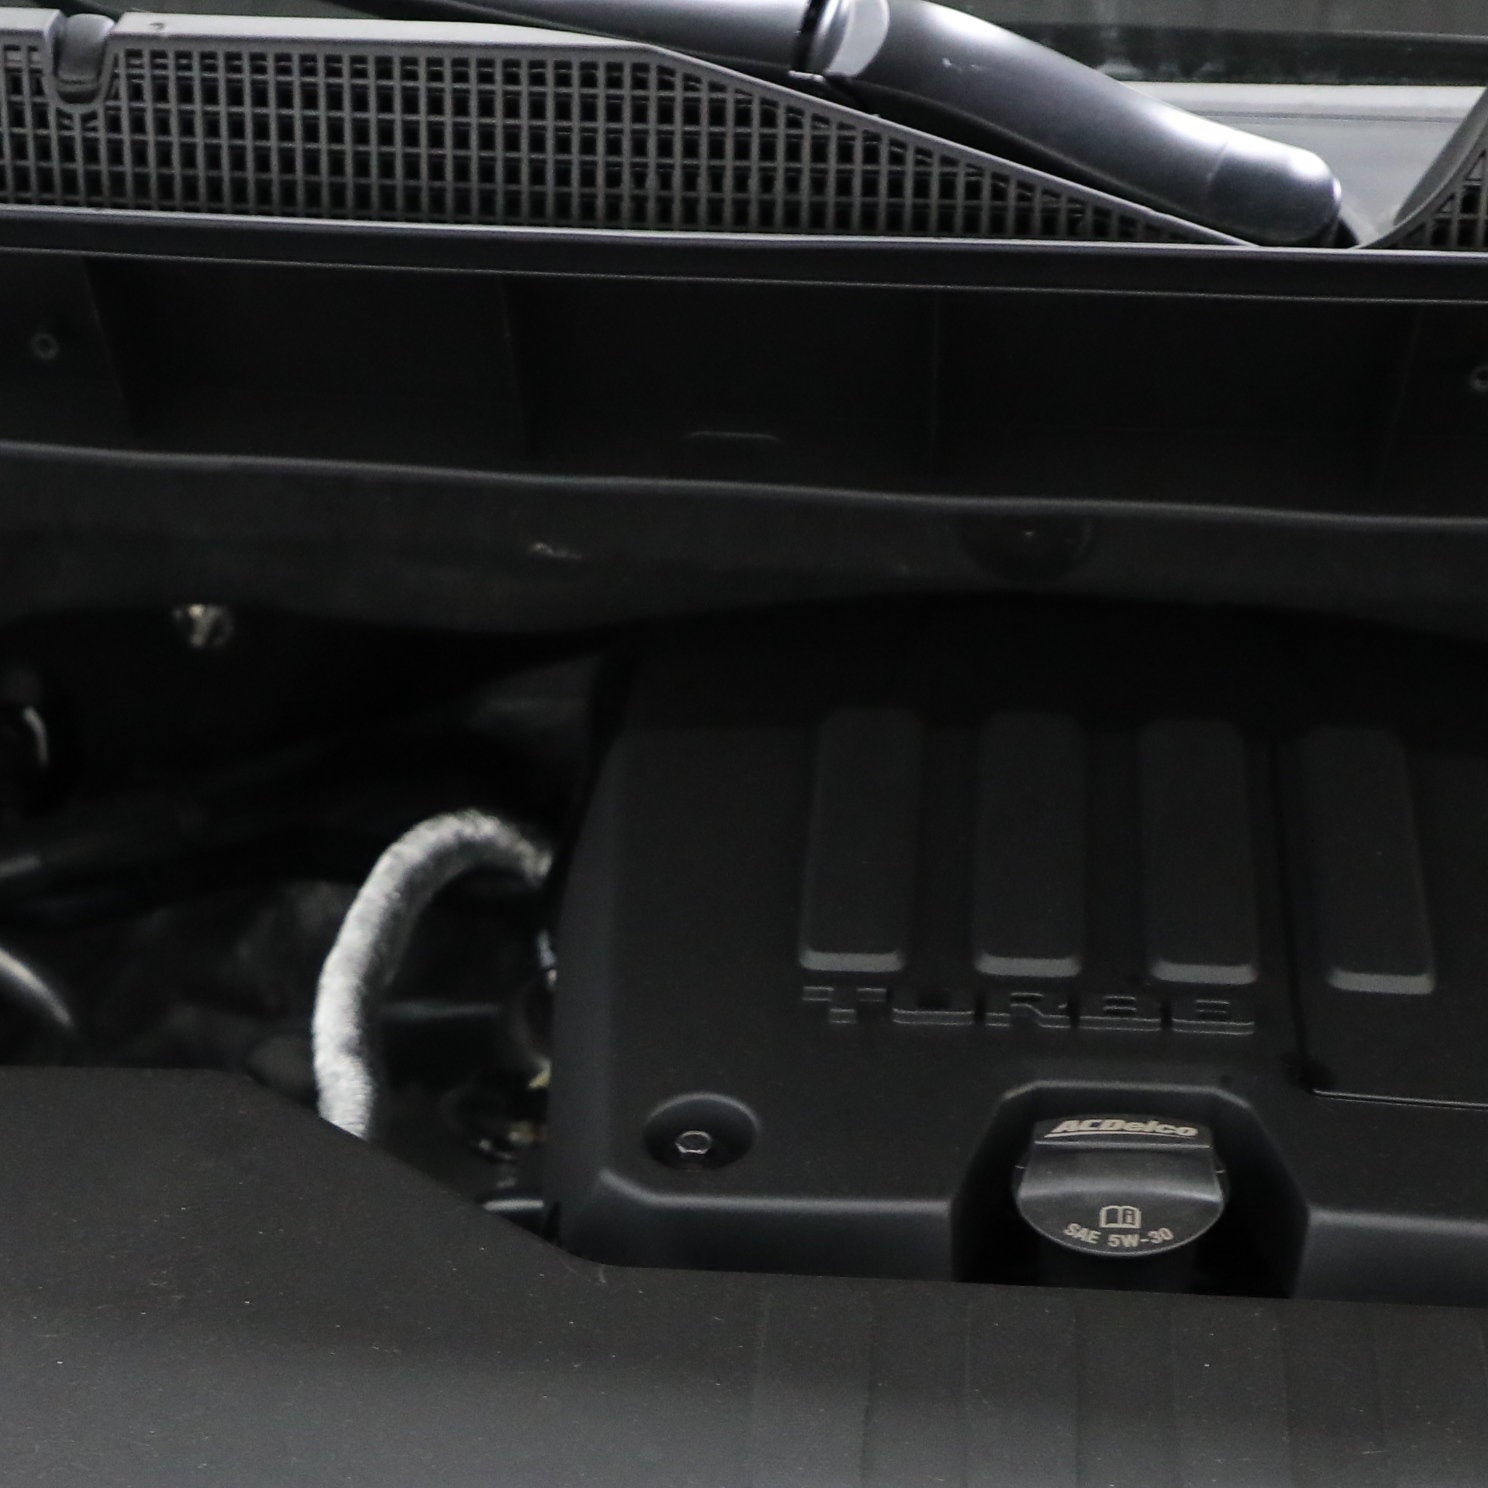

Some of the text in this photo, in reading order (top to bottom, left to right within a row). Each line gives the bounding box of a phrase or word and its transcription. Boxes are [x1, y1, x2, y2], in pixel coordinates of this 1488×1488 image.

[1049, 1118, 1199, 1137] ACDelco
[1063, 1222, 1174, 1248] SAE 5W-30
